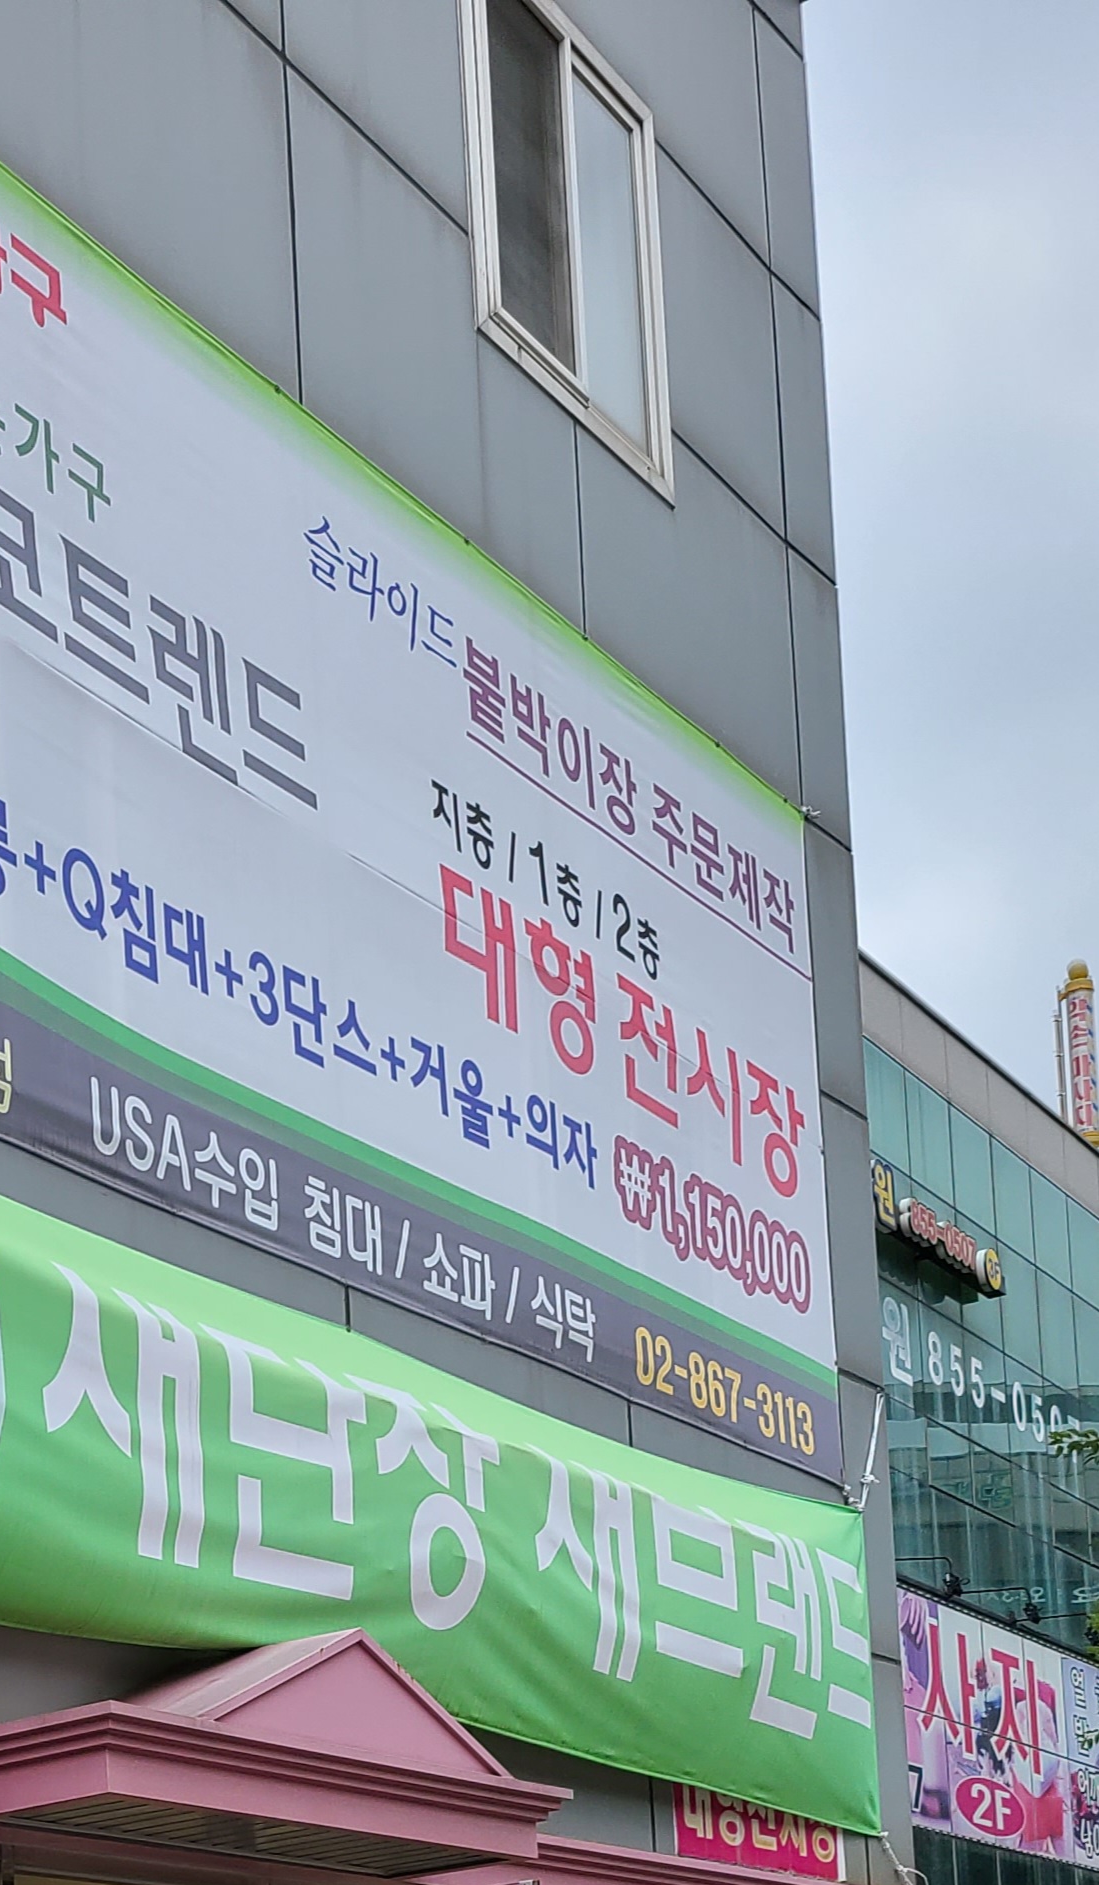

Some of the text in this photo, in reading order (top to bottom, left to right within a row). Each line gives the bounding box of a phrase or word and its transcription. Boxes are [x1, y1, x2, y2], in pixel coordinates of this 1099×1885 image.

[463, 636, 639, 835] 붙박이장
[652, 782, 796, 955] 주문제작
[439, 863, 806, 1198] 대형 전시장
[90, 1076, 280, 1230] USA수입
[634, 1326, 815, 1456] 02-867-3113
[882, 1296, 913, 1387] 원
[42, 1261, 872, 1740] 새단장 새브랜드
[970, 1783, 1011, 1831] 2F
